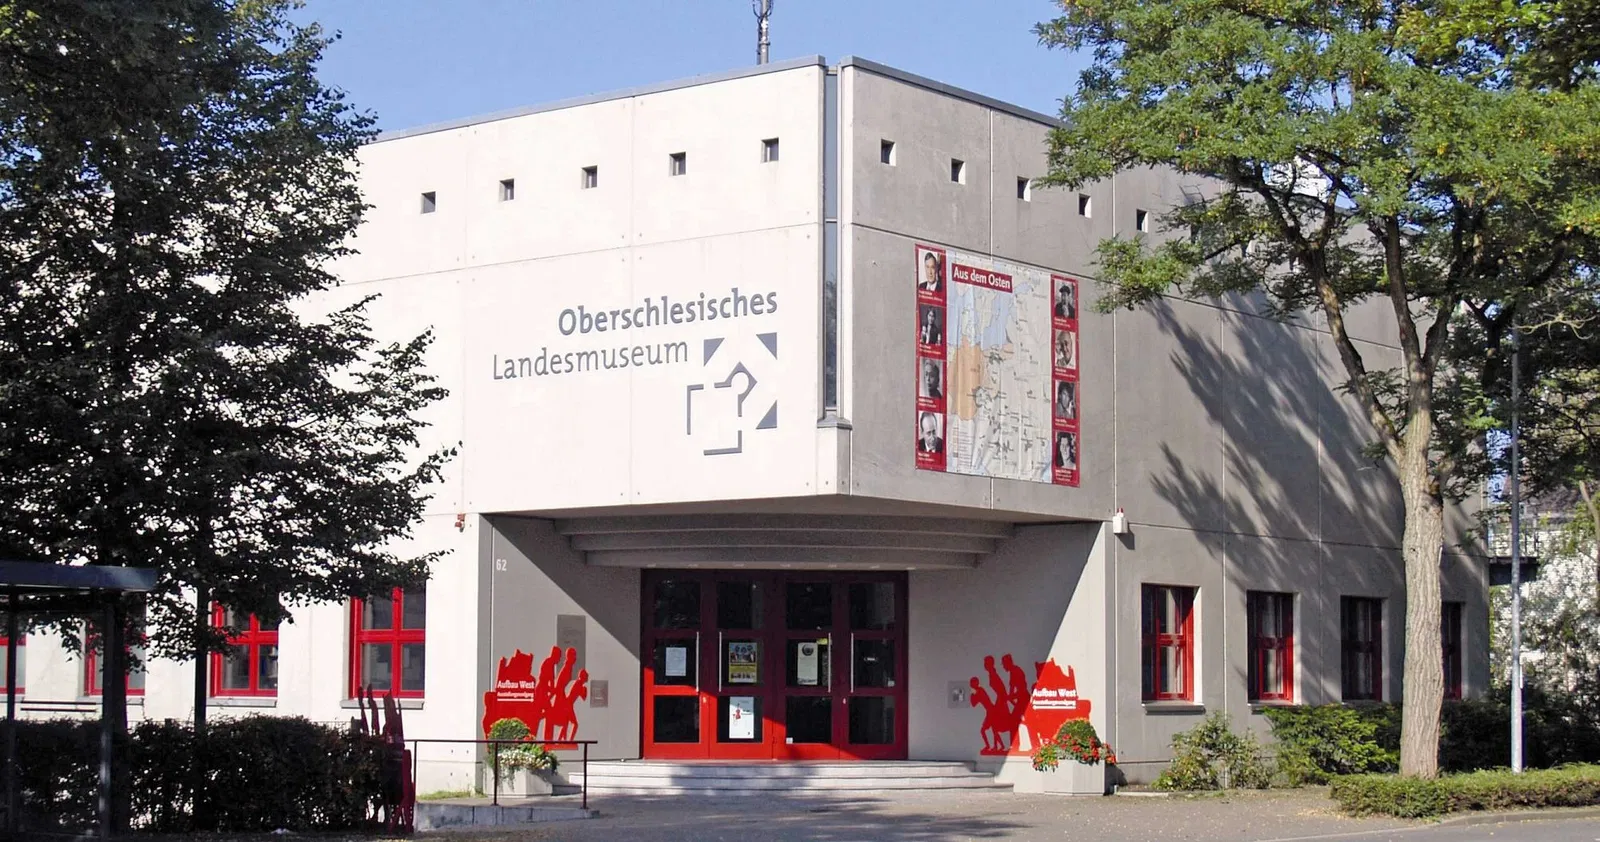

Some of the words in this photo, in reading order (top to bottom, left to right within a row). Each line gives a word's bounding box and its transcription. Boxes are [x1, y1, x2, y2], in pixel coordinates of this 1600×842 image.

[953, 266, 969, 281] Aus
[970, 269, 987, 285] dem
[988, 274, 1011, 290] Osten
[558, 287, 778, 336] Oberschlesisches
[493, 341, 688, 380] Landesmuseum
[496, 559, 507, 571] 62
[497, 679, 519, 689] Aufbau
[519, 680, 535, 689] West
[1032, 687, 1057, 697] Aufbau
[1057, 688, 1077, 697] West
